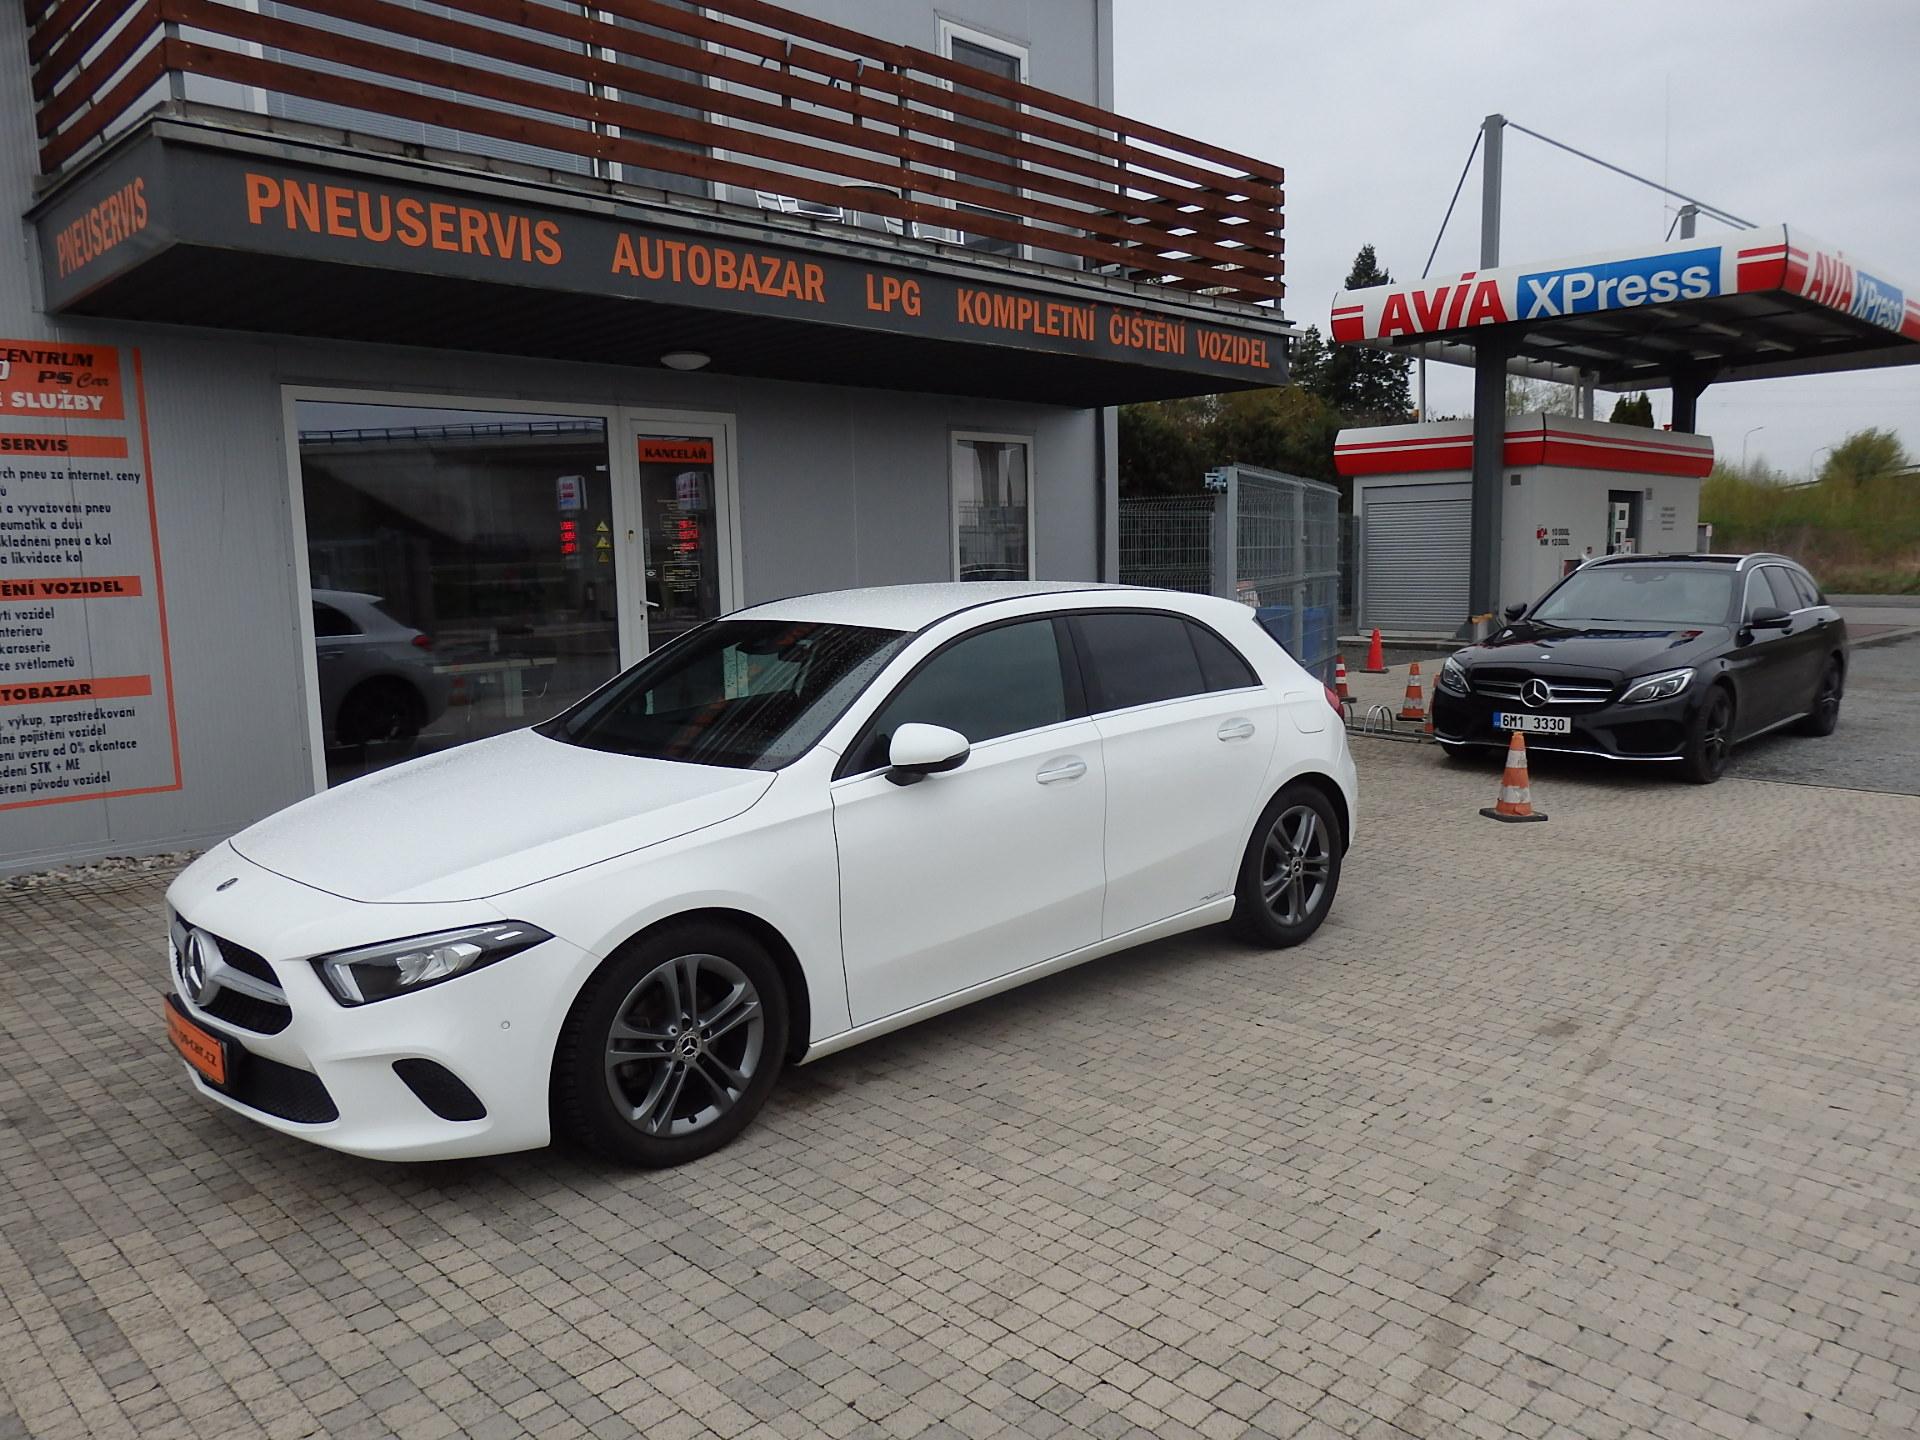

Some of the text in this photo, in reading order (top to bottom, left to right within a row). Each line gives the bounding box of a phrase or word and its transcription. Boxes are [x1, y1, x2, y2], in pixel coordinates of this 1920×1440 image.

[56, 176, 148, 279] PNEUSERVIS
[244, 172, 1270, 369] PNEUSERVIS AUTOBAZAR LPG KOMPLETNÍ ČIŠTĚNÍ VOZIDEL
[1526, 263, 1709, 320] XPress
[38, 370, 73, 385] PS
[11, 390, 103, 411] SLUŽBY
[1, 438, 68, 451] SERVIS
[20, 470, 47, 483] pneu
[50, 471, 64, 480] za
[116, 471, 141, 484] ceny
[86, 504, 111, 516] pneu
[50, 521, 57, 530] a
[0, 534, 112, 549] kladnění pneu a kol
[11, 551, 62, 565] likvidace
[66, 551, 83, 563] kol
[41, 581, 124, 596] VOZIDEL
[15, 607, 55, 620] vozidel
[2, 684, 93, 701] TOBAZAR
[1503, 715, 1565, 731] 6M1 3330
[69, 724, 107, 739] vozidel
[53, 744, 67, 757] od
[70, 742, 85, 755] 0%
[89, 739, 137, 753] akontace
[30, 762, 52, 775] STK
[66, 758, 80, 771] ME
[73, 771, 111, 787] vozidel
